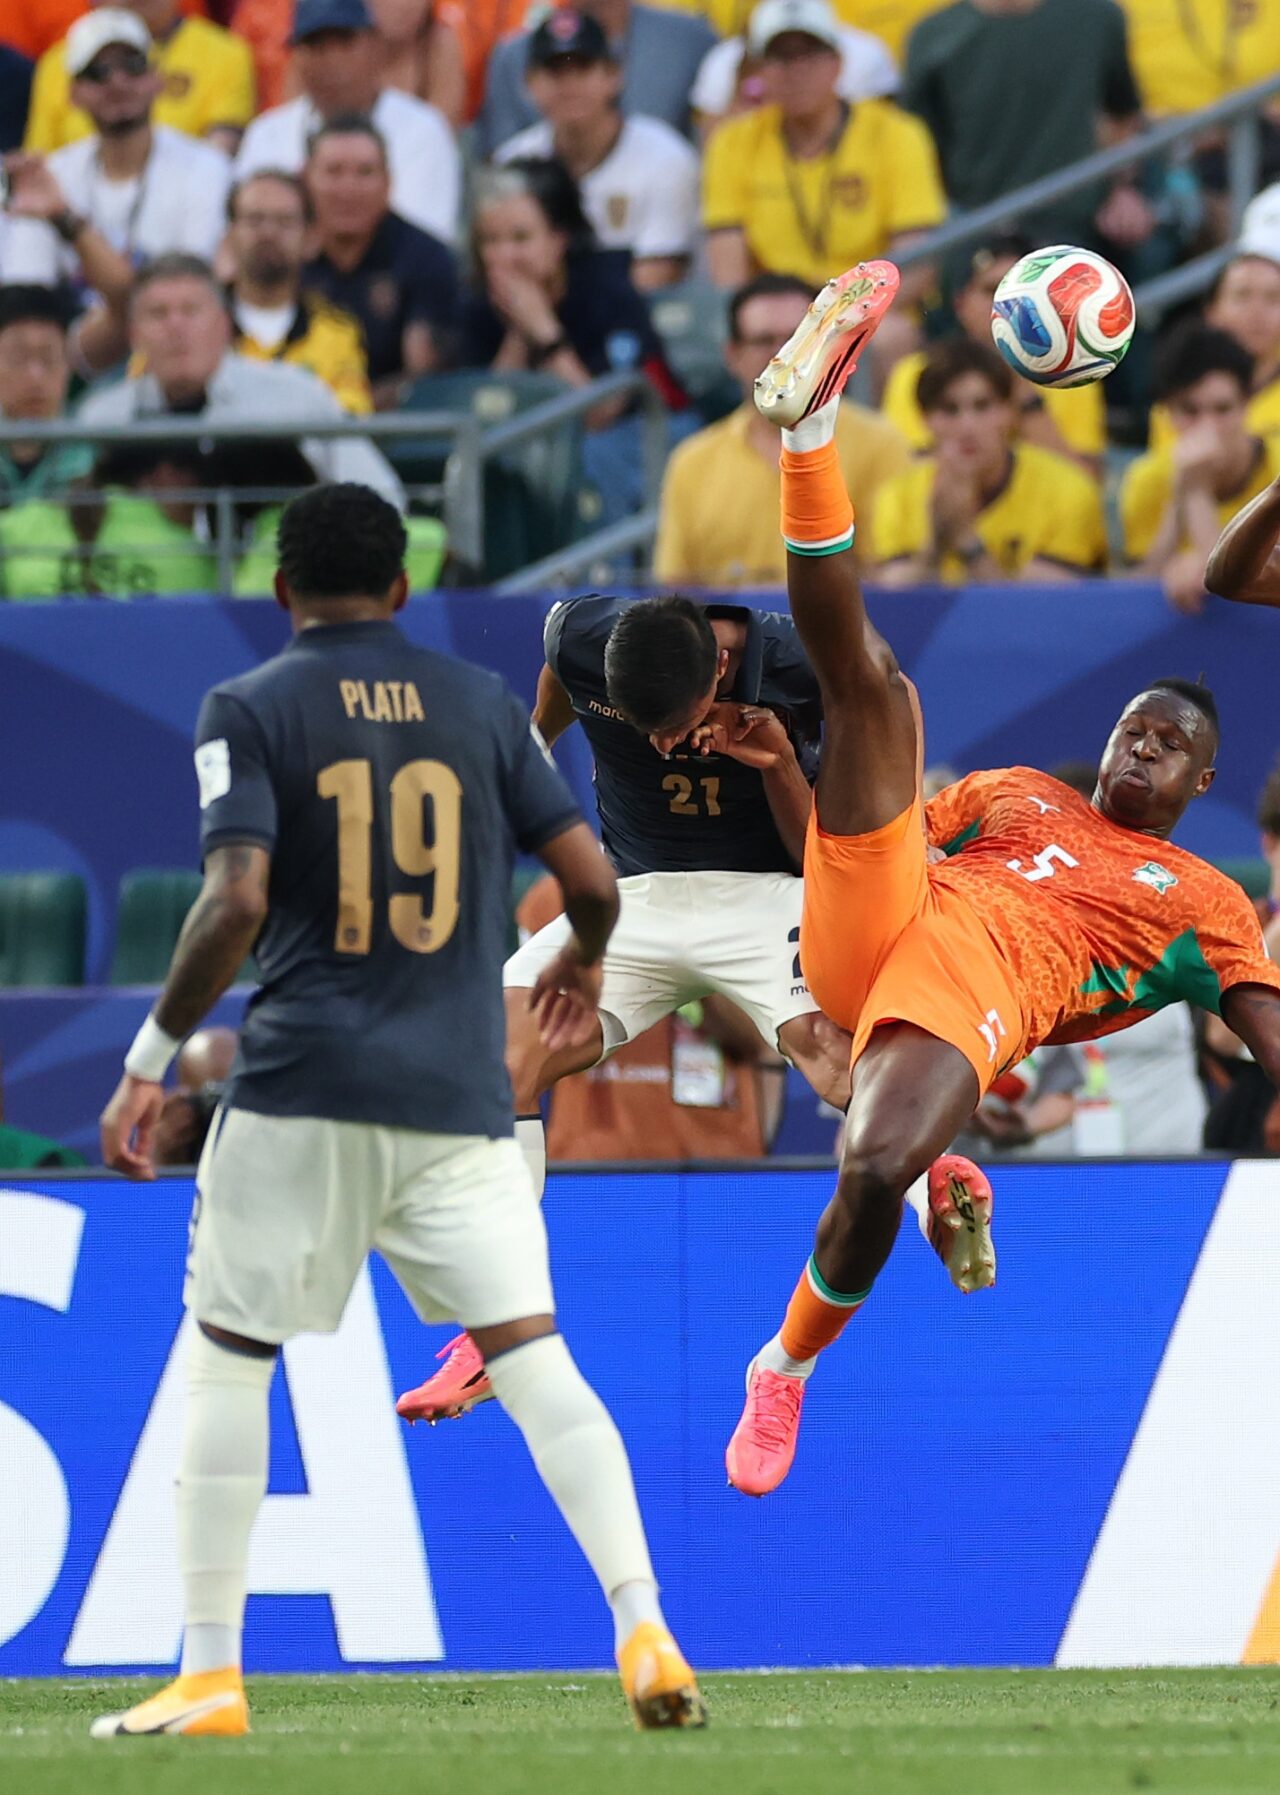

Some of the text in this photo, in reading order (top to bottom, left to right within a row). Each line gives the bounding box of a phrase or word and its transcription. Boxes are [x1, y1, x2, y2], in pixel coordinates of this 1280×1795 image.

[339, 679, 426, 722] PLATA
[662, 773, 721, 816] 21
[317, 758, 464, 954] 19
[1006, 844, 1080, 882] 5
